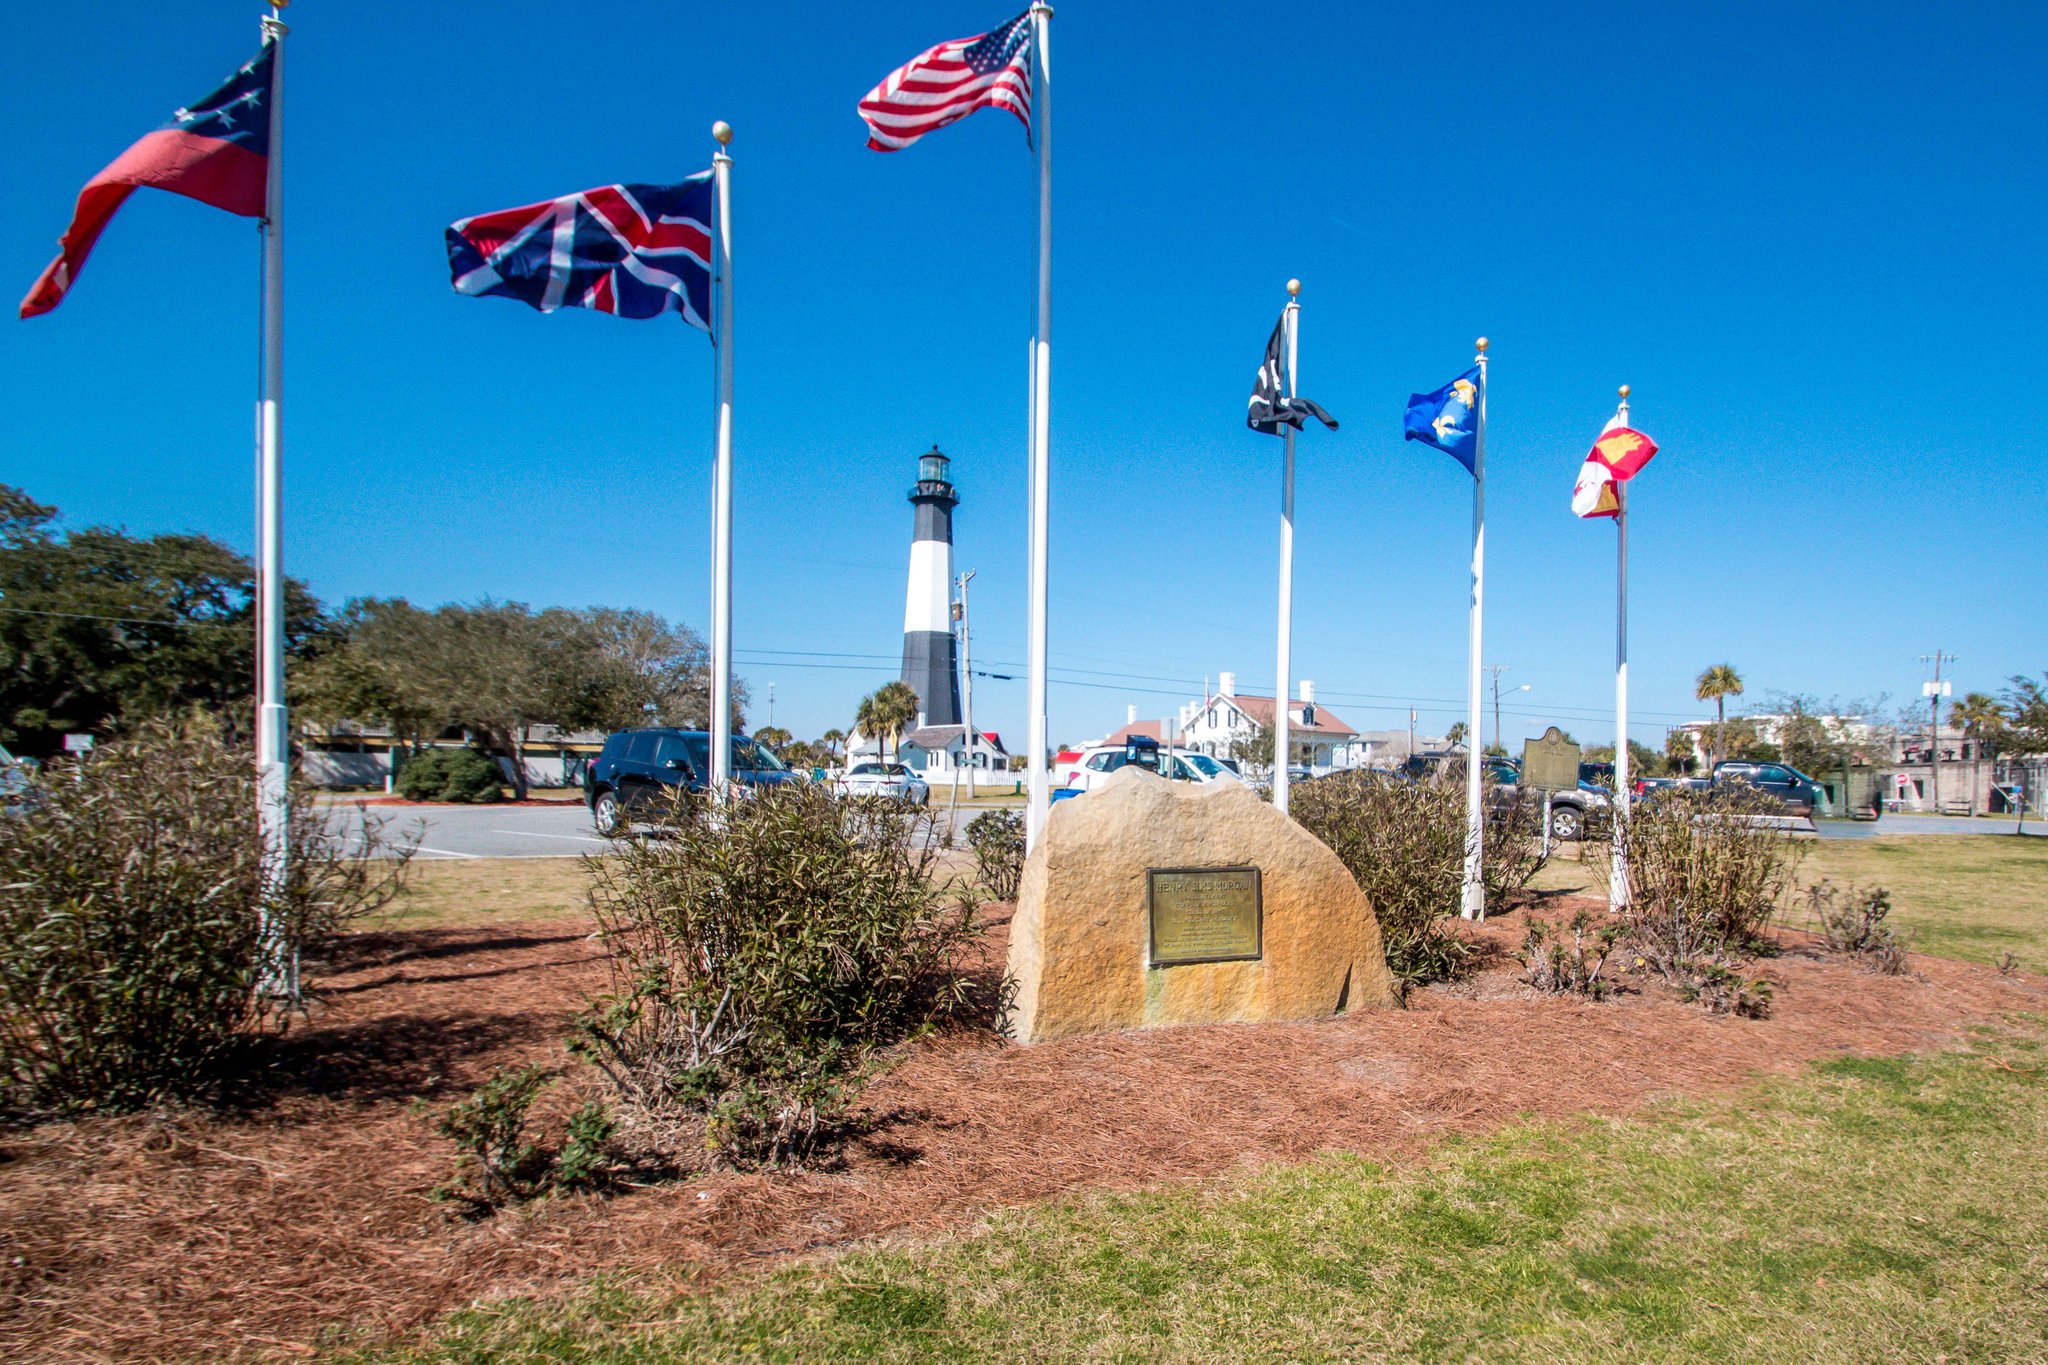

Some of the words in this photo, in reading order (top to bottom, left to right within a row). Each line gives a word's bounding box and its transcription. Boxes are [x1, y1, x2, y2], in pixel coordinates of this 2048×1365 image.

[1156, 882, 1189, 893] HENRY
[1192, 881, 1213, 892] SIMS
[1215, 880, 1253, 891] MORGAN
